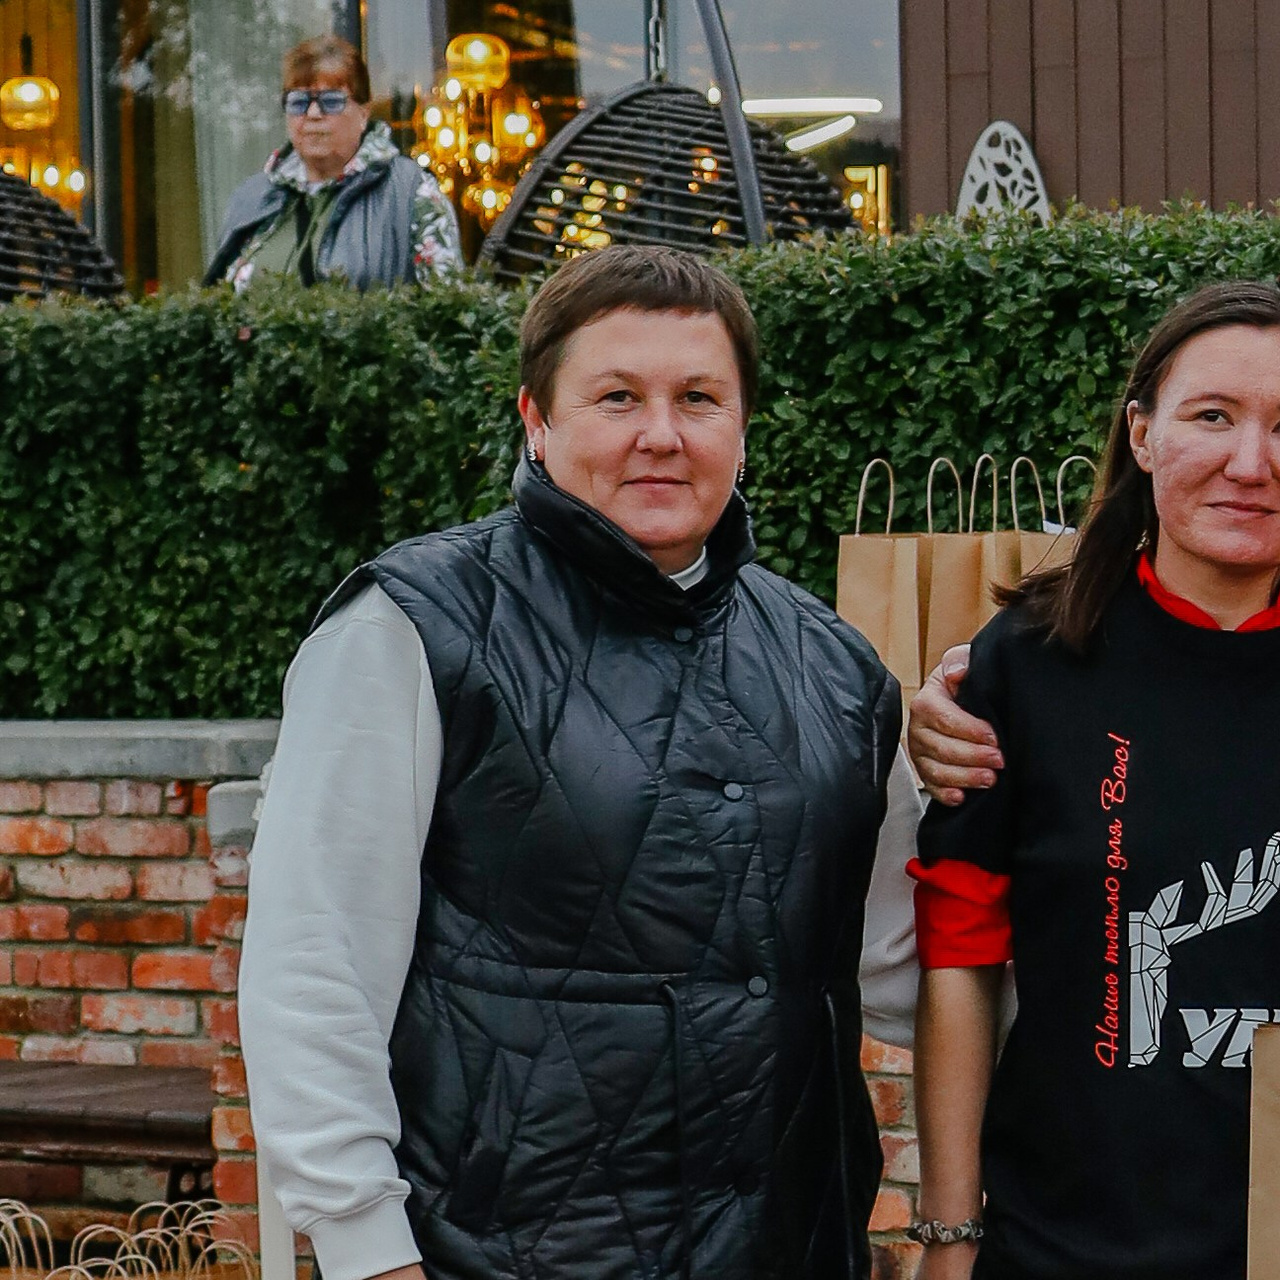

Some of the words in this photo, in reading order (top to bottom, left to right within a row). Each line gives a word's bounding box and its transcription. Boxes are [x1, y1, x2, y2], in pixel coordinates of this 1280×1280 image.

[1100, 731, 1131, 811] Вас!
[1107, 818, 1128, 870] для
[1104, 877, 1120, 964] тепло
[1095, 973, 1119, 1068] Наше
